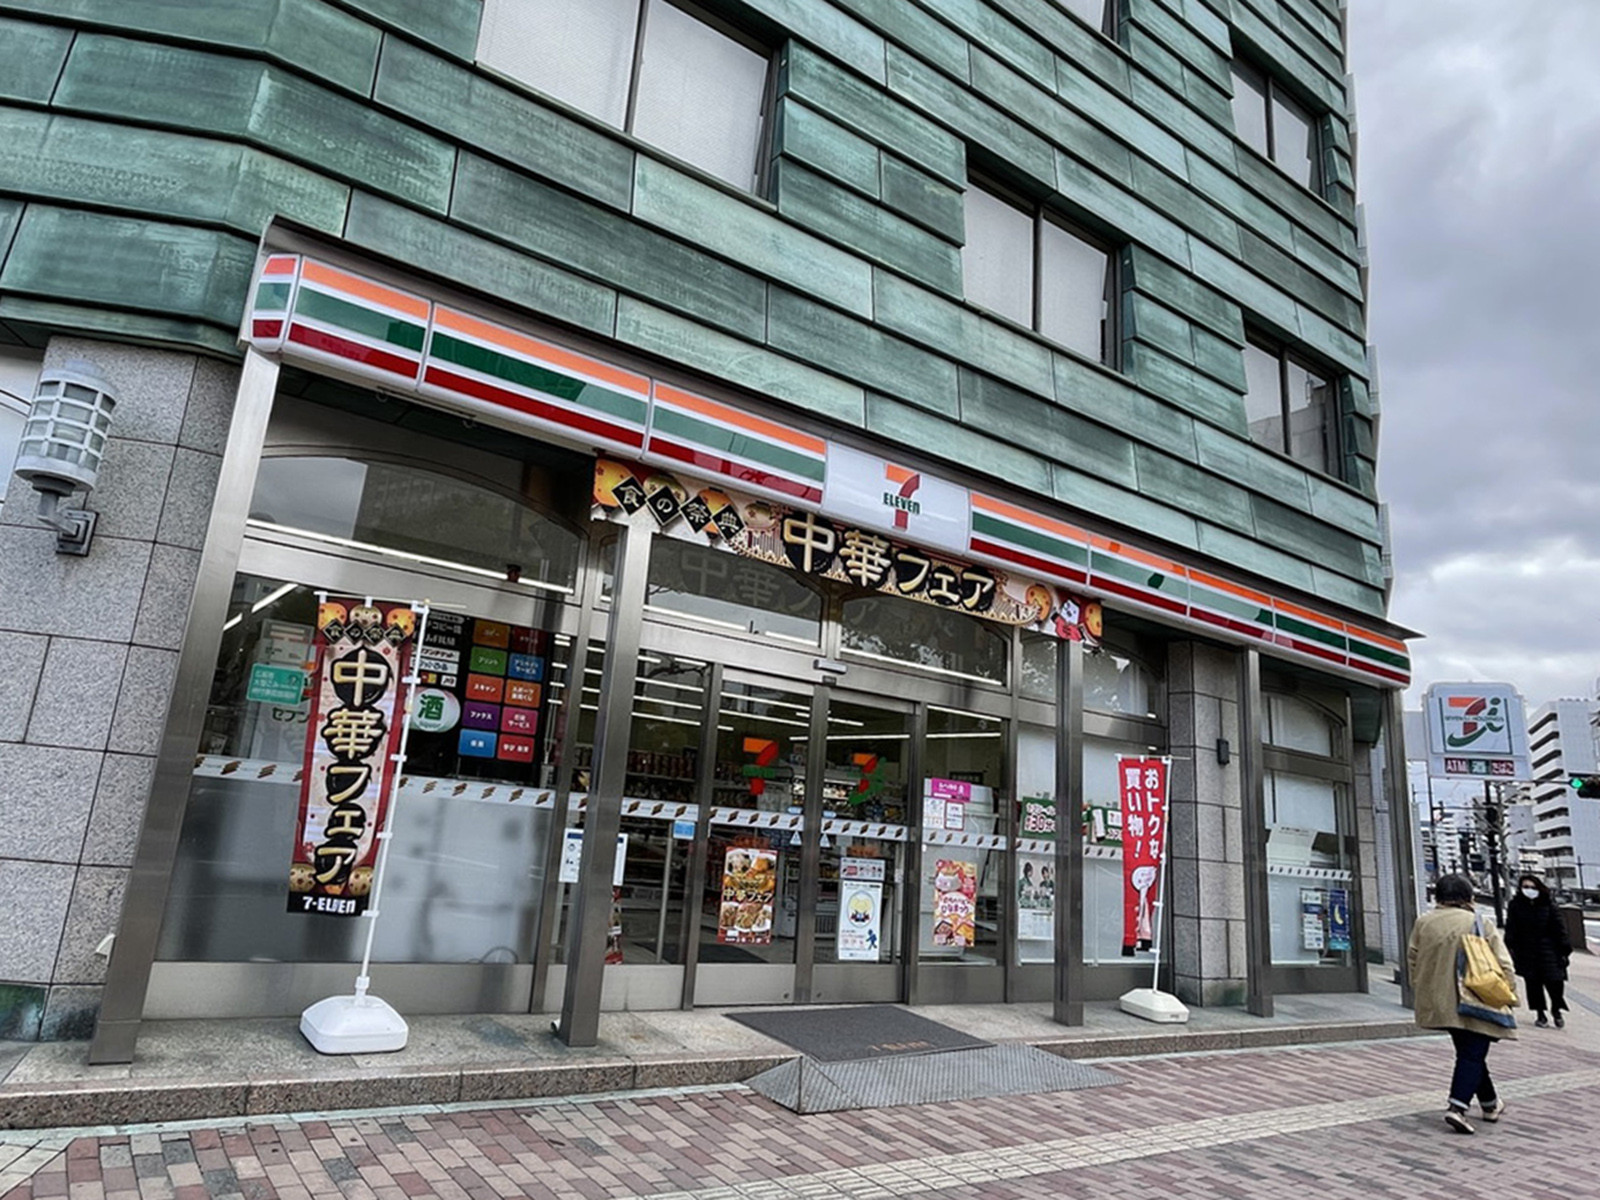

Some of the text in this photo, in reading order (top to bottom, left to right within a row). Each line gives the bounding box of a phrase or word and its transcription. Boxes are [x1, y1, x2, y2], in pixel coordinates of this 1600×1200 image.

[619, 485, 739, 533] 食の祭典
[883, 492, 921, 515] ELEVEN
[783, 512, 994, 609] 中華フェア
[418, 693, 445, 721] 酒
[316, 650, 389, 884] 中華フェア
[1446, 759, 1468, 773] ATM
[1144, 769, 1161, 860] おトクな
